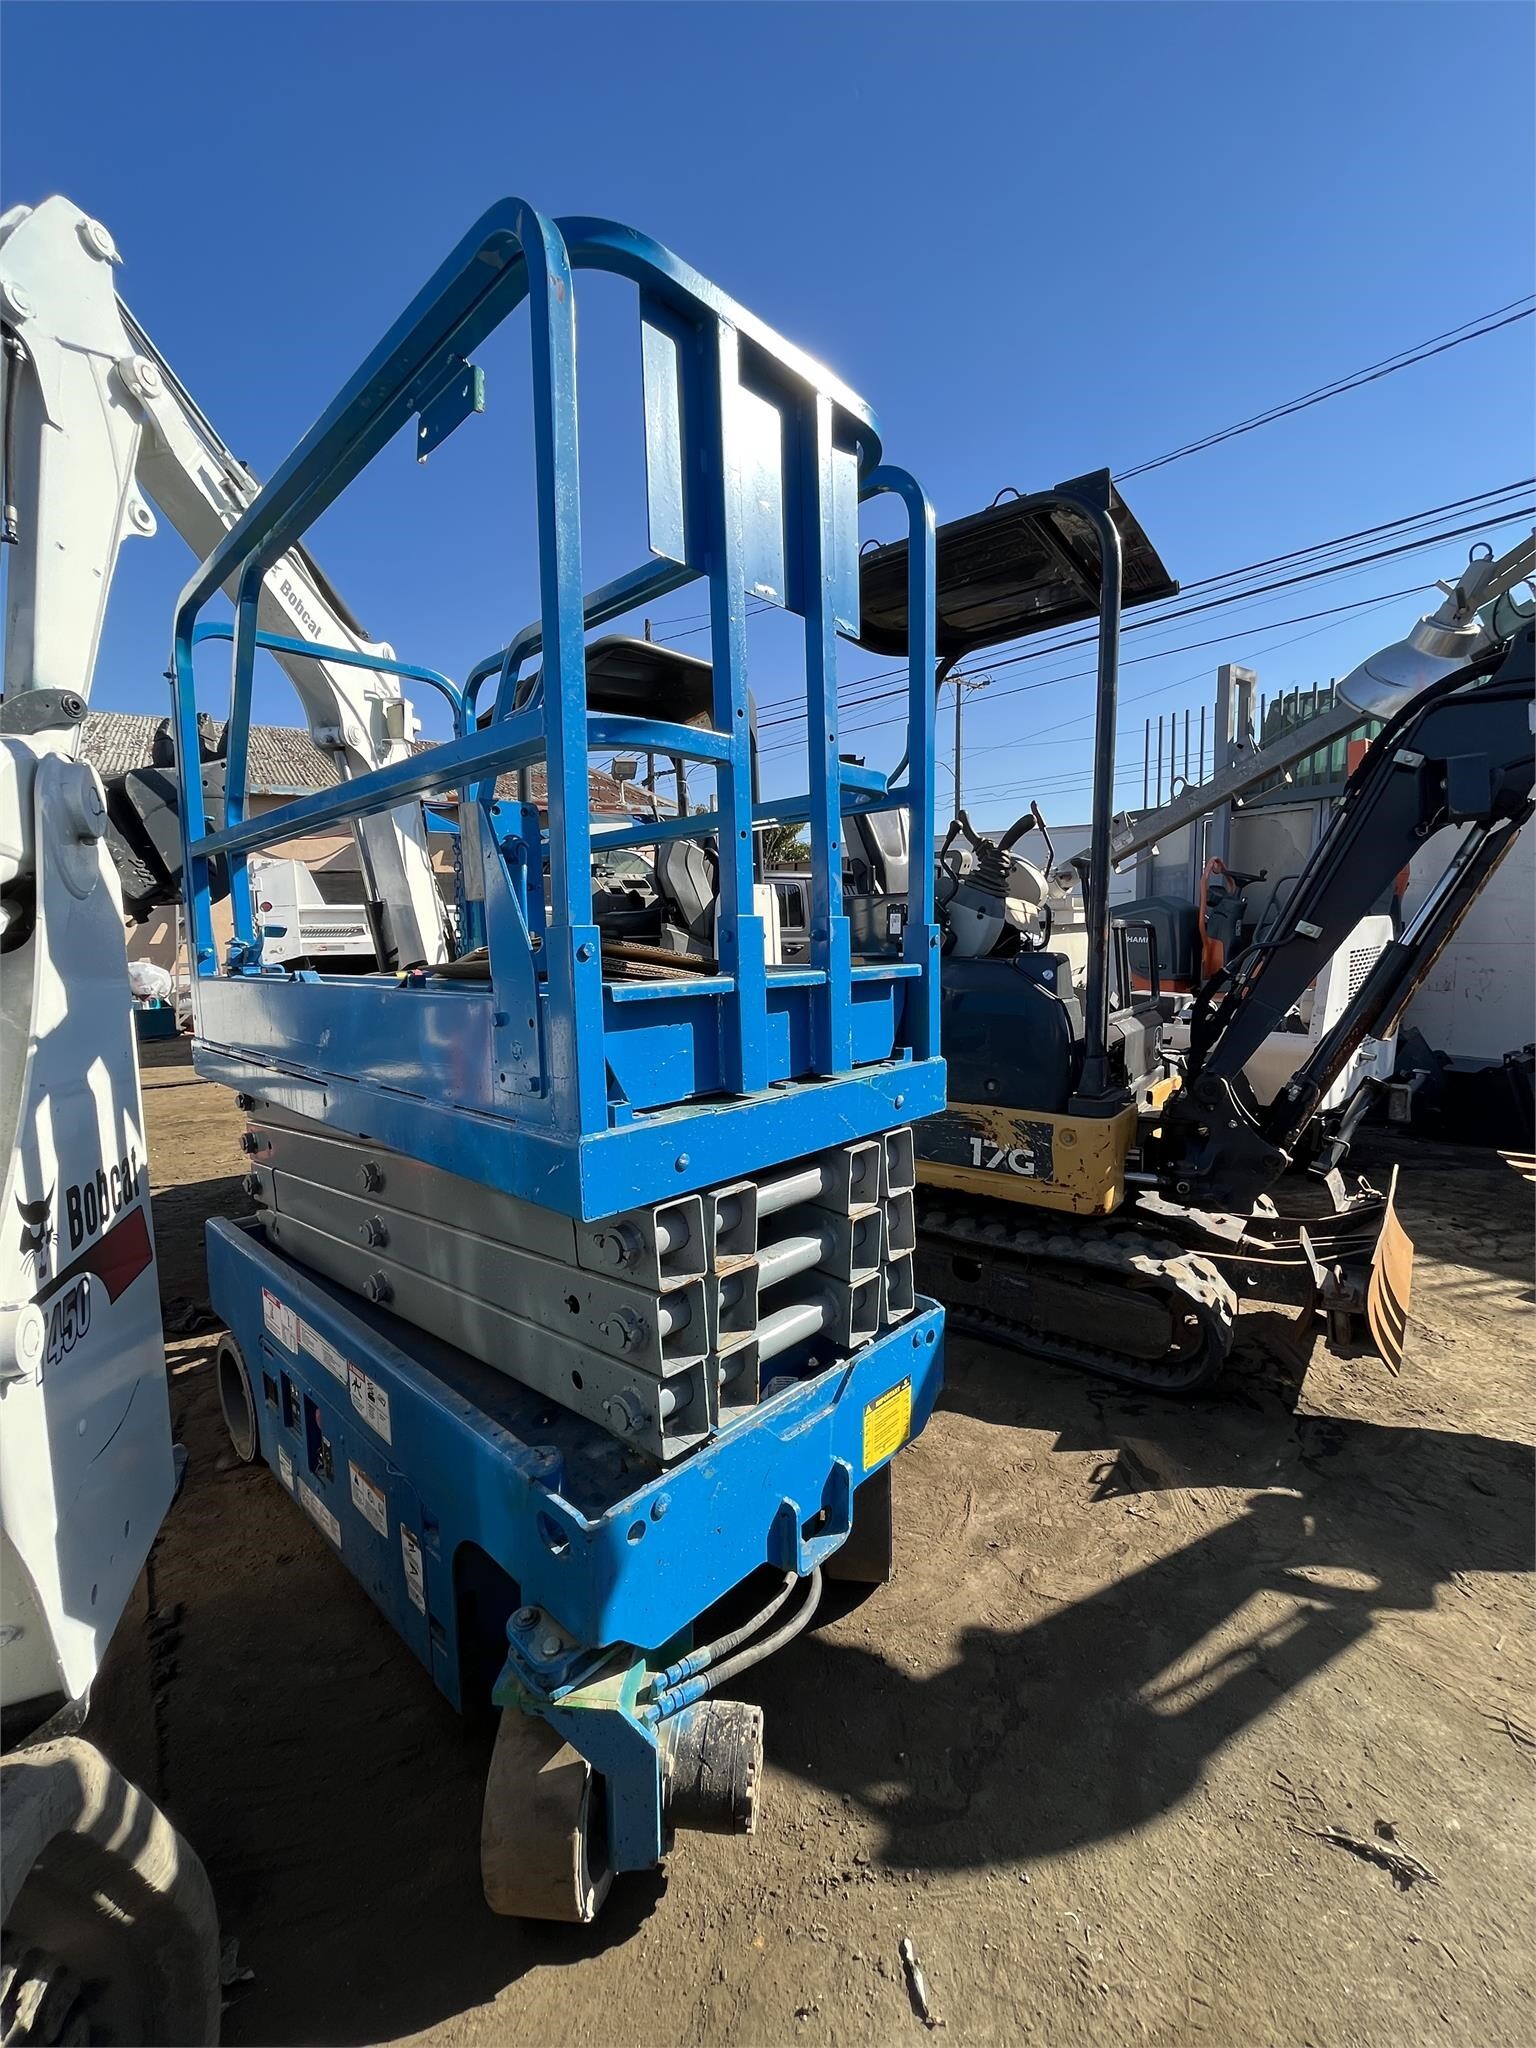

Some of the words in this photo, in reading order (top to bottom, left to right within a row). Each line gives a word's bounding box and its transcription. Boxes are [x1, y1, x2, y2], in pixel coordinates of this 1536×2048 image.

[280, 579, 322, 640] Bobcat
[970, 1137, 1035, 1175] 17G
[66, 1145, 140, 1251] Bobcat
[36, 1277, 91, 1386] 450
